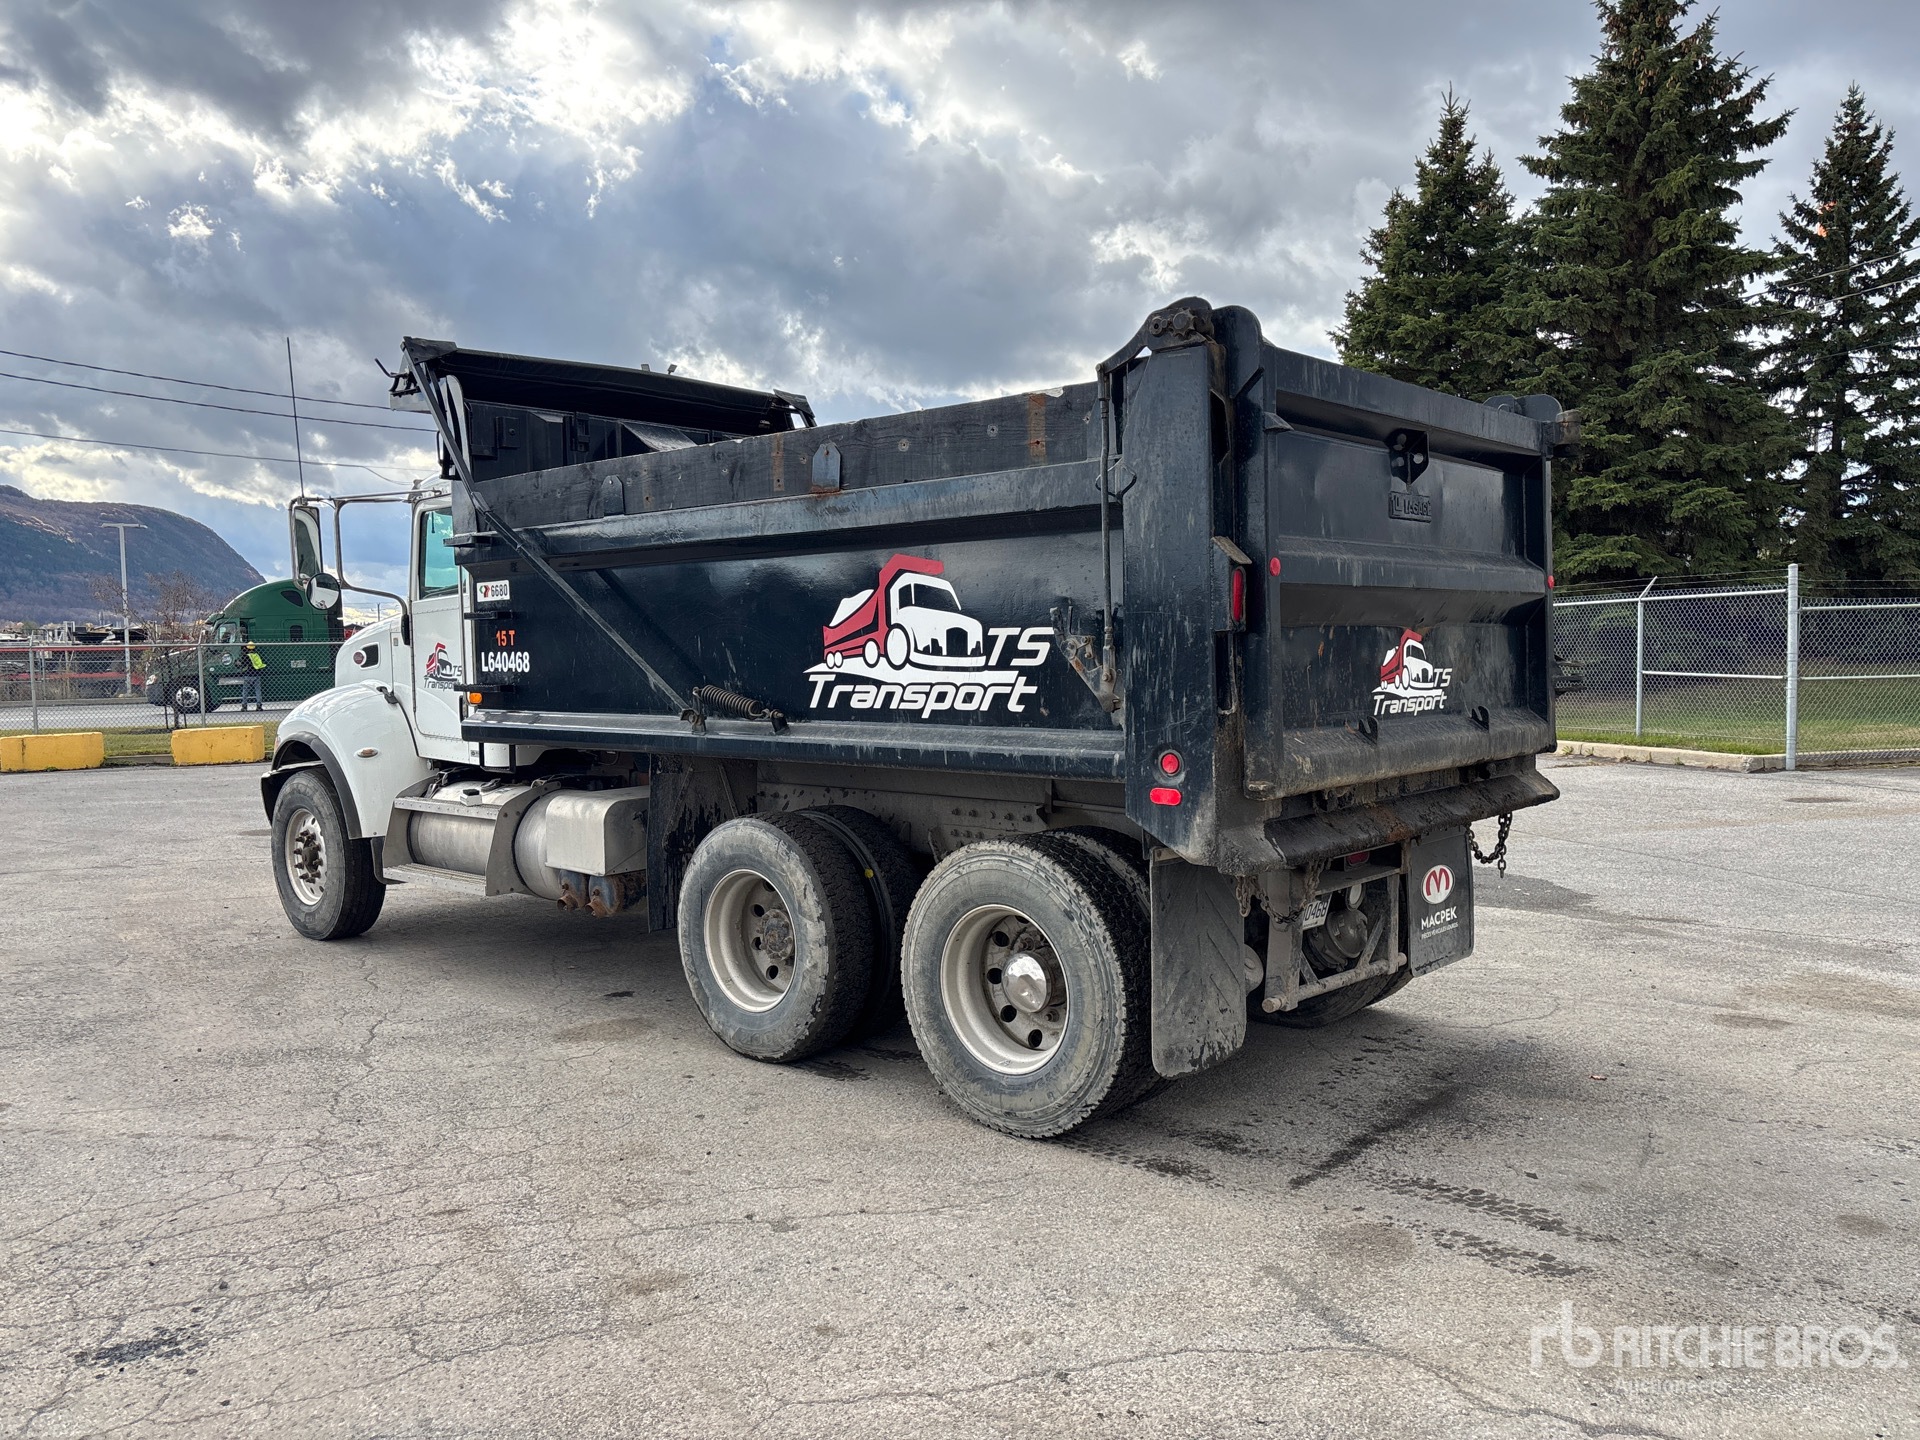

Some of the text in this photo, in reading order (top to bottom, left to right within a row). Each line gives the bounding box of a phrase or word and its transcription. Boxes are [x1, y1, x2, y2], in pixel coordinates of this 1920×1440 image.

[490, 583, 508, 598] 6680
[495, 629, 507, 647] 15
[987, 626, 1055, 667] TS
[453, 665, 463, 677] TS
[481, 651, 531, 673] L640468
[423, 677, 461, 692] Transpo
[1433, 667, 1453, 688] TS
[808, 674, 1038, 719] Transport
[1373, 690, 1448, 717] Transport
[1420, 905, 1458, 931] MACPEK
